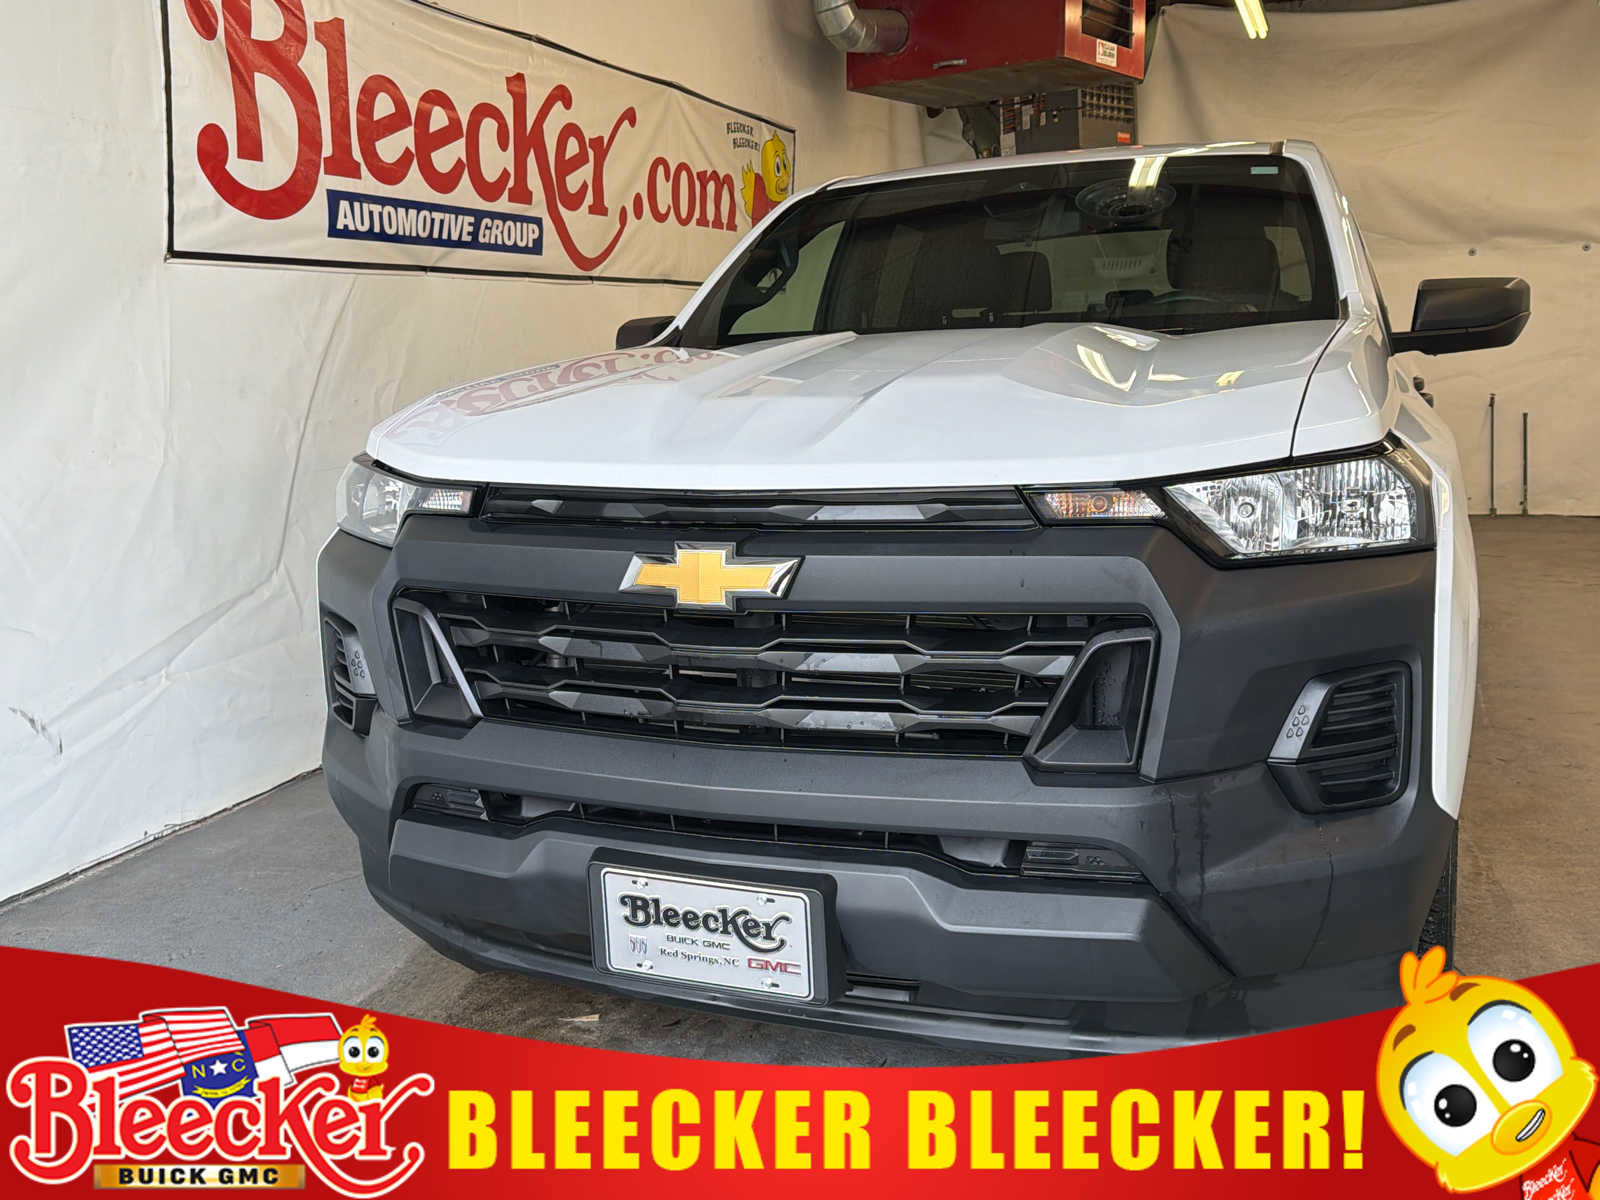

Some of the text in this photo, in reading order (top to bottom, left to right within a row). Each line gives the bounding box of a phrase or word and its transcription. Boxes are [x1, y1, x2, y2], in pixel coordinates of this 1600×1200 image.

[336, 200, 540, 248] AUTOMOTIVE GROUP
[619, 894, 792, 953] Bleecker
[660, 947, 679, 957] Red
[666, 934, 731, 951] BUICK GMC
[747, 957, 802, 976] GMC
